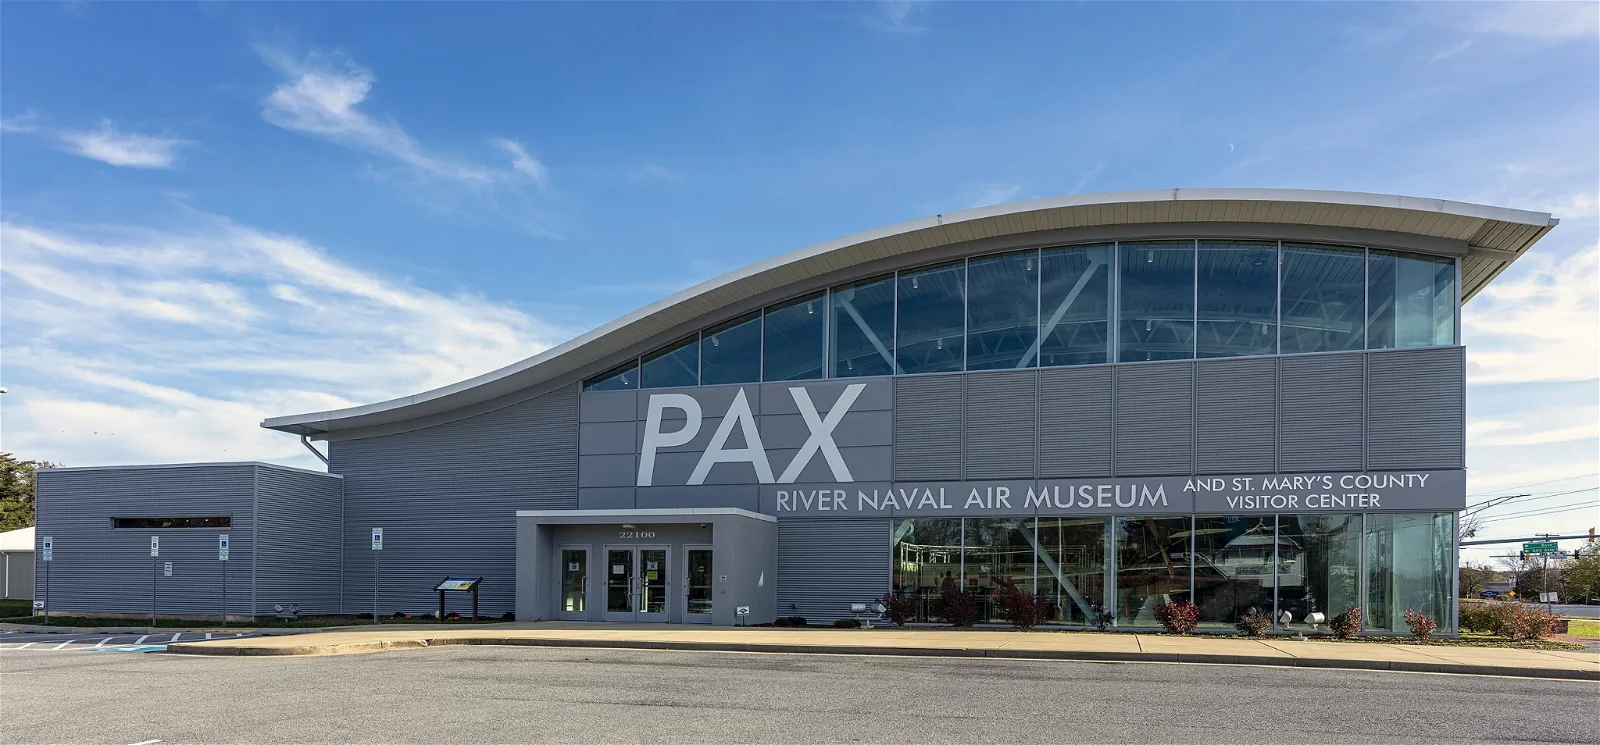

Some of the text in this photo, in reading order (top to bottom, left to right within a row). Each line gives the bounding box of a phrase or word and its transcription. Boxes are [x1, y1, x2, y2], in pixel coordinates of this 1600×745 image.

[637, 384, 867, 487] PAX
[1183, 473, 1430, 492] AND ST. MARY'S COUNTY
[776, 483, 1168, 511] RIVER NAVAL AIR MUSEUM
[1226, 493, 1381, 509] VISITOR CENTER
[619, 531, 656, 539] 22100
